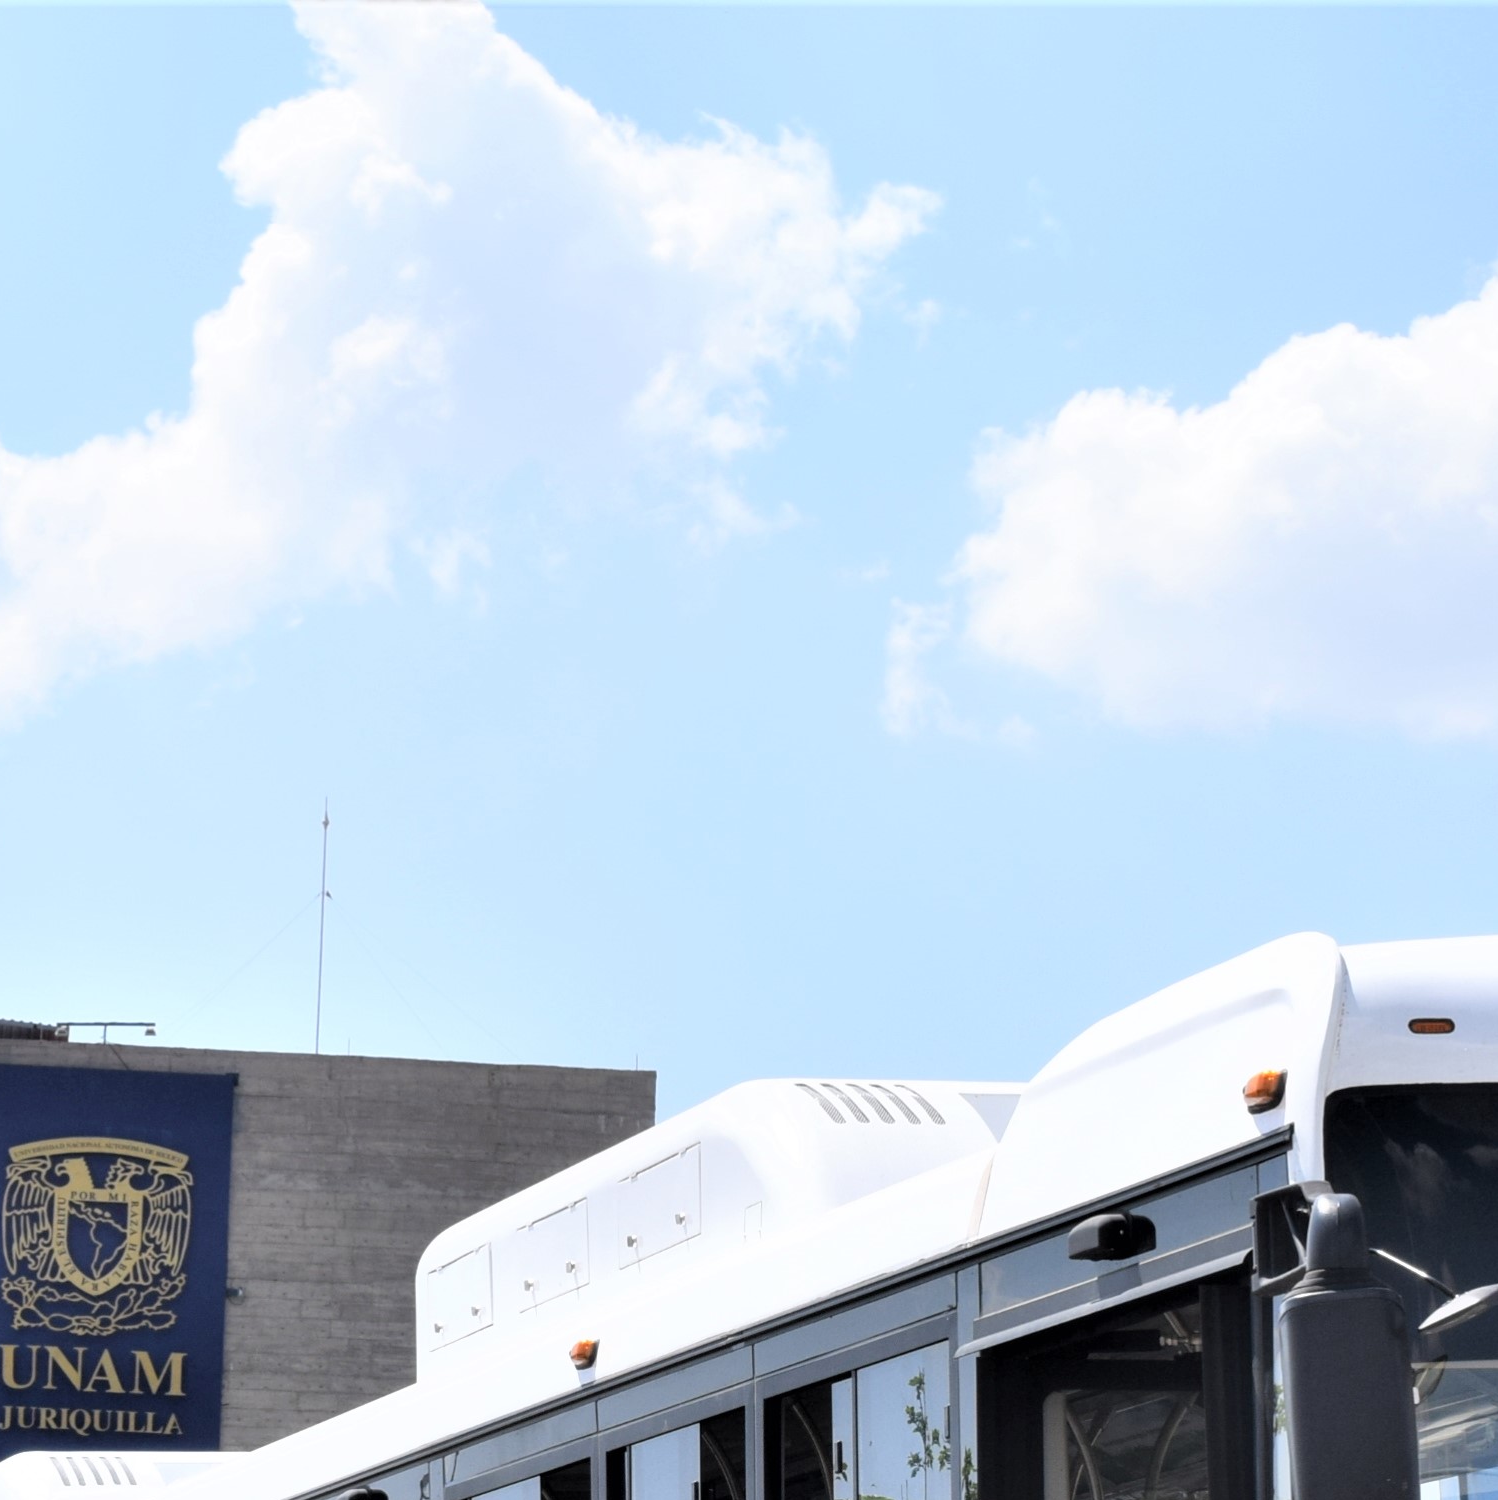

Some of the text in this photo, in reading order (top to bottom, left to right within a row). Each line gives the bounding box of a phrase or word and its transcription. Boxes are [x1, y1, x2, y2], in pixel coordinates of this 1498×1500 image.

[71, 1191, 127, 1201] POR MI
[129, 1201, 139, 1235] RAZA
